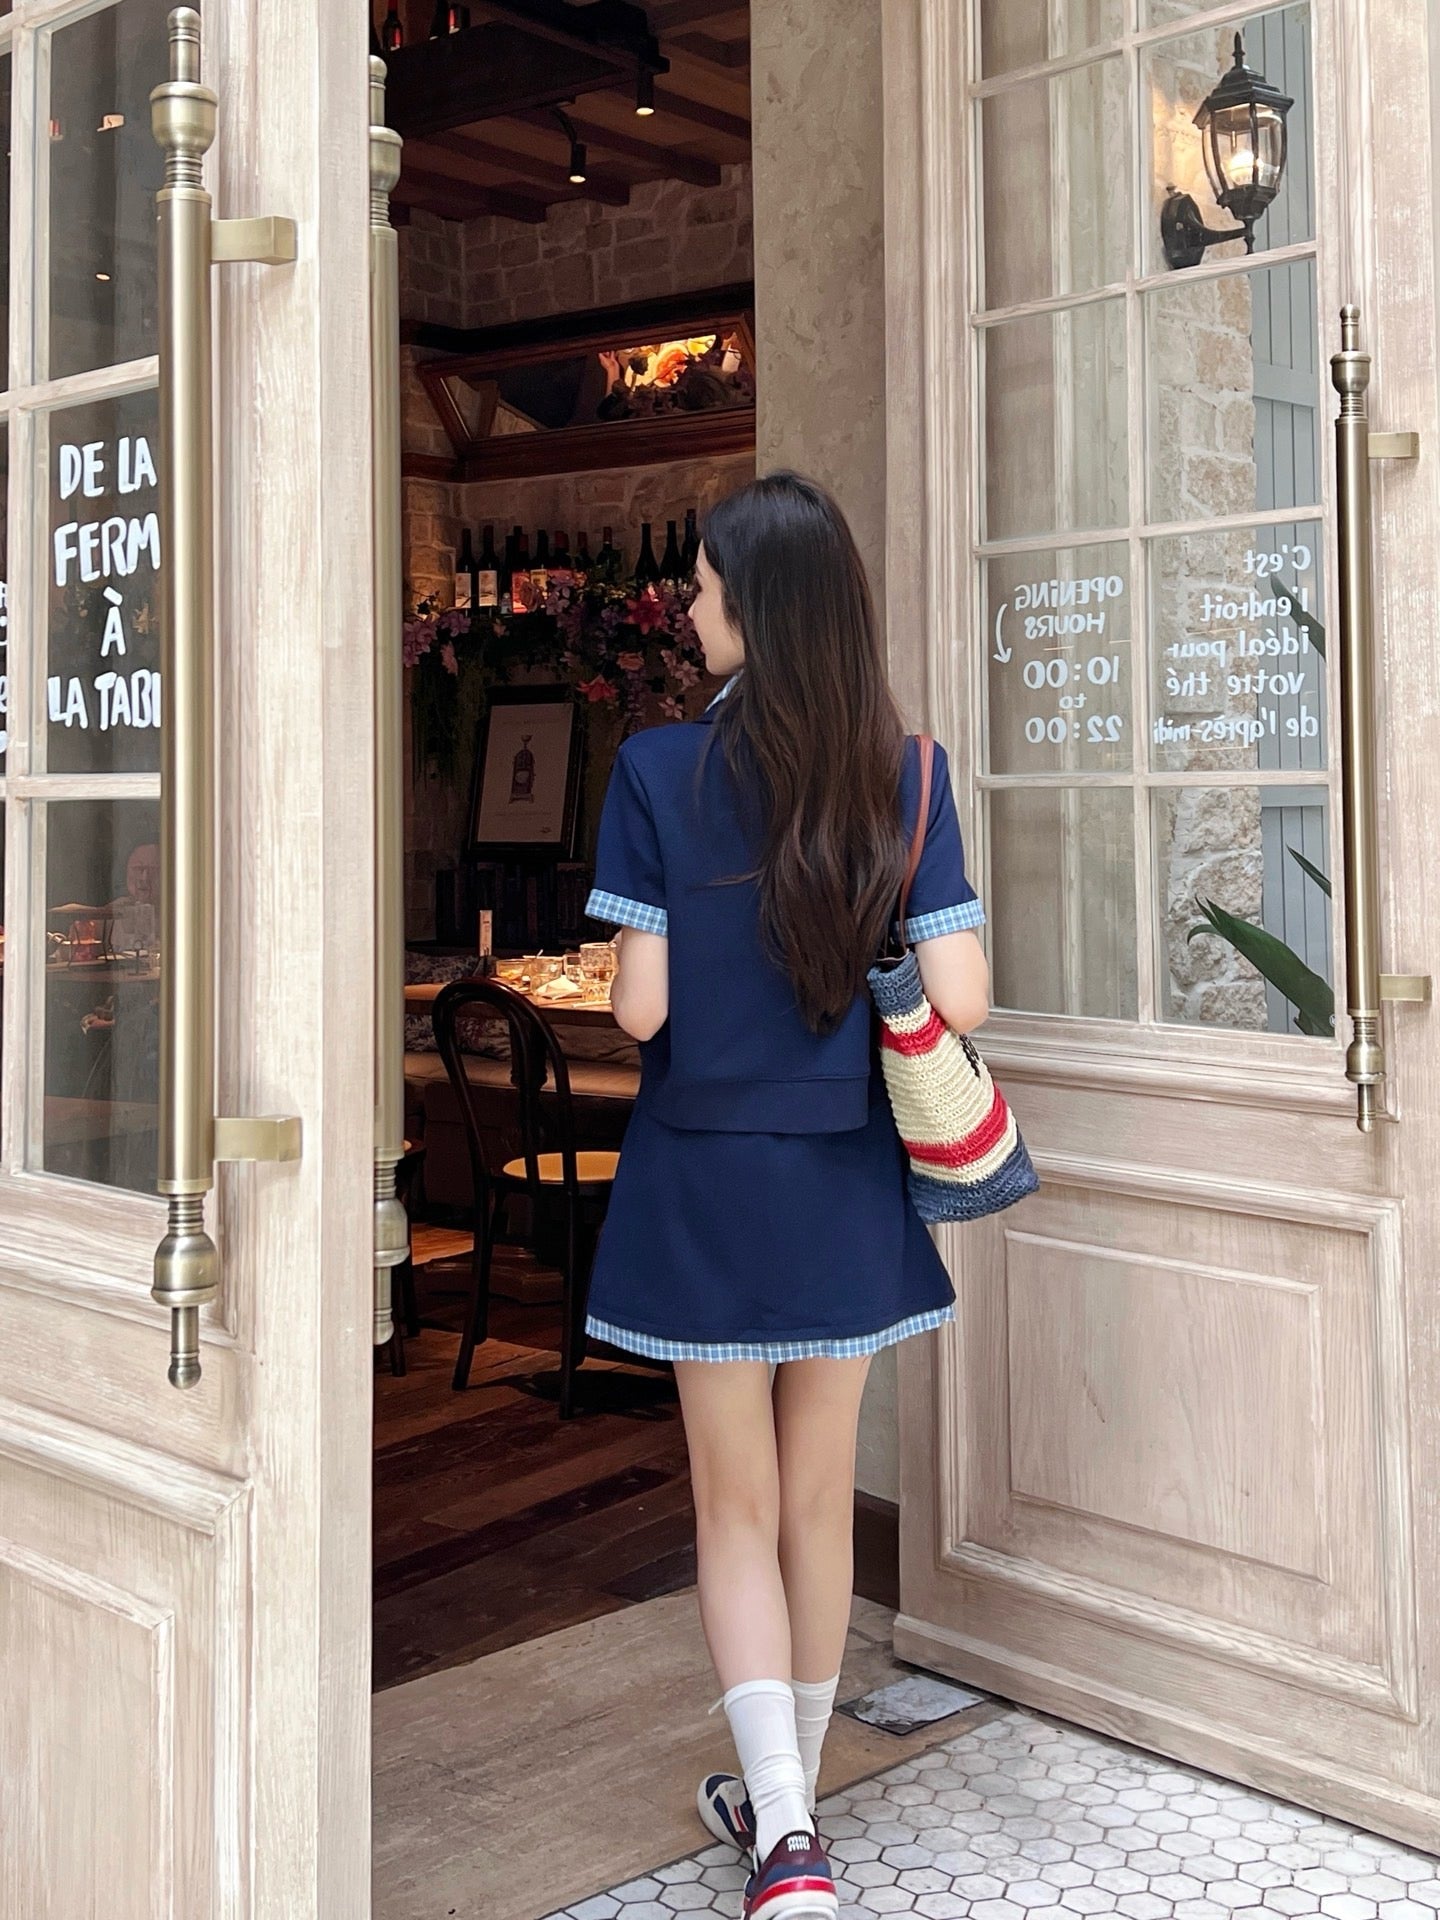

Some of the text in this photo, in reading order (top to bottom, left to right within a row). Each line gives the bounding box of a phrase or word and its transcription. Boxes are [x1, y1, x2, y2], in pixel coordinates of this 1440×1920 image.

[59, 436, 157, 500] DE LA
[100, 586, 127, 657] À
[47, 676, 89, 729] LA
